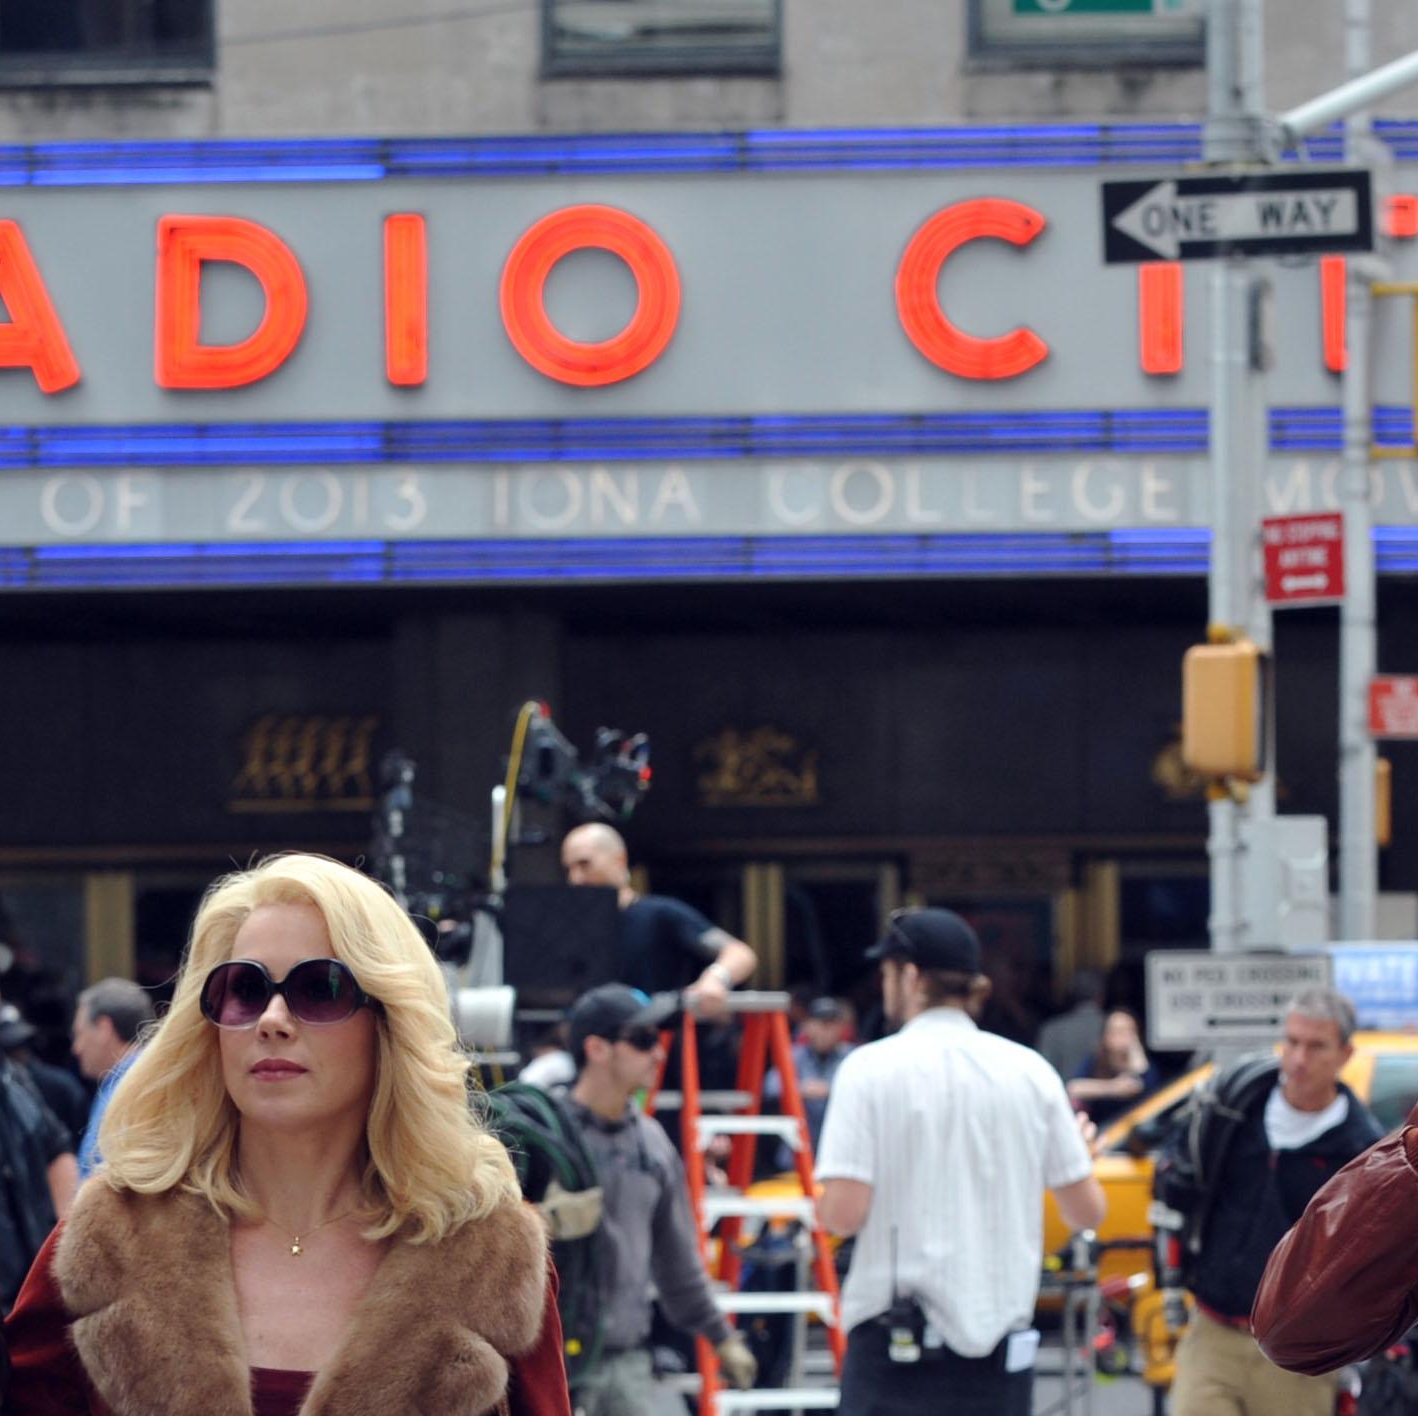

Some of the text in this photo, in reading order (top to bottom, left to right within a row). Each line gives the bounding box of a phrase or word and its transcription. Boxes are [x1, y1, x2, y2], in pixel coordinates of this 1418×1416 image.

[1141, 195, 1340, 238] ONE WAY
[40, 471, 152, 537] OF
[226, 468, 428, 534] 2013
[490, 465, 702, 531] IONA
[768, 460, 1180, 527] COLLEGE
